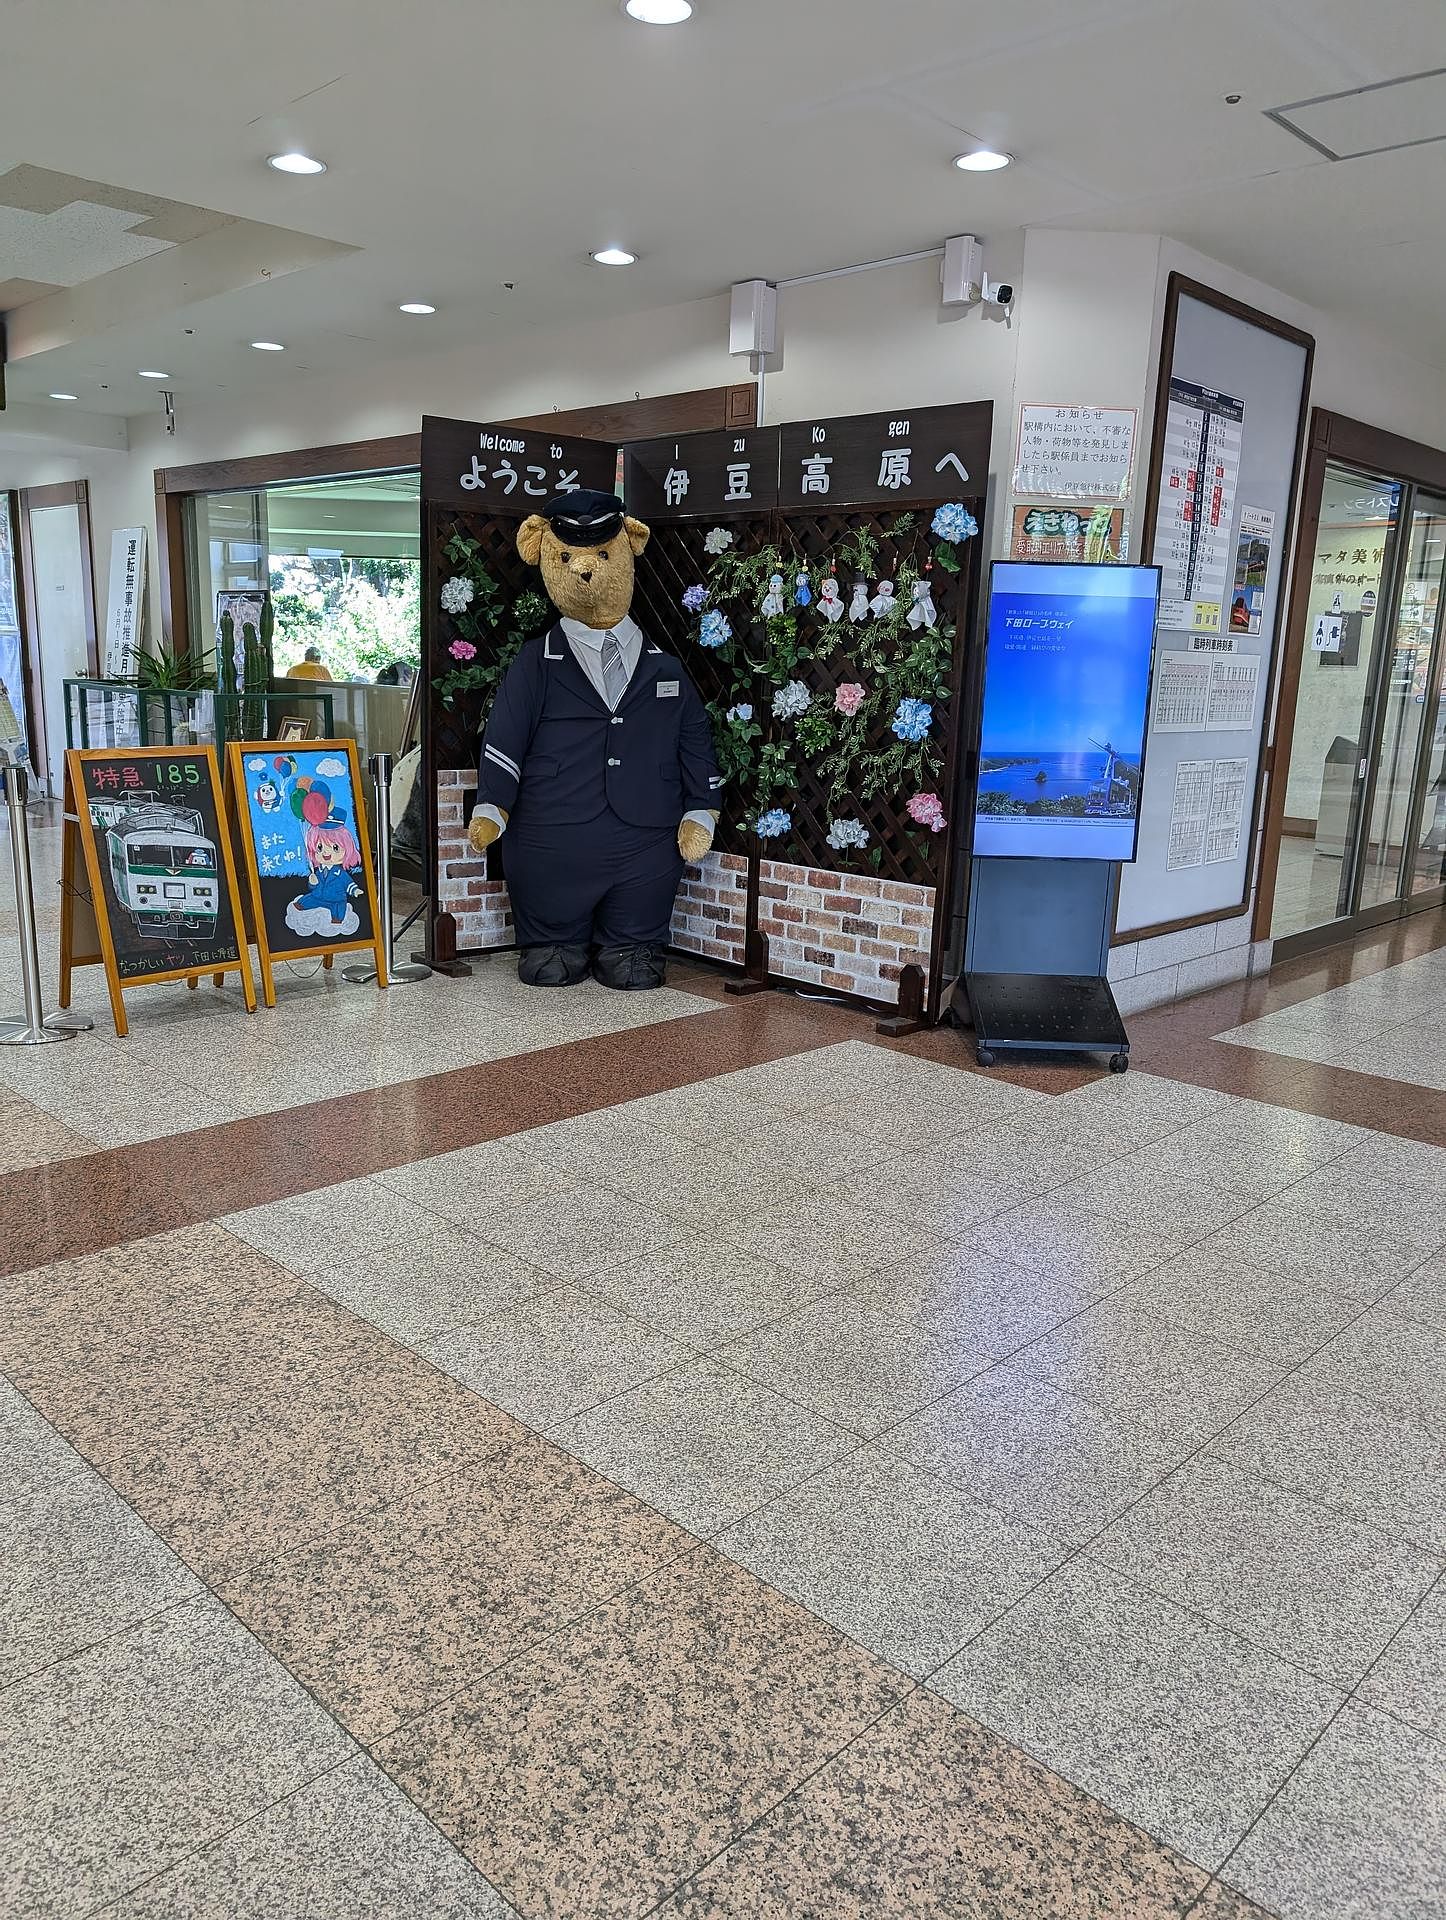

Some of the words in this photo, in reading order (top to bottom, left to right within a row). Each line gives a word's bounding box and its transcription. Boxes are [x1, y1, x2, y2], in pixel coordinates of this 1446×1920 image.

[1055, 408, 1104, 420] お知らせ
[480, 432, 525, 454] Welcome
[550, 443, 563, 459] to
[733, 438, 745, 453] zu
[812, 426, 826, 443] Ko
[888, 420, 910, 438] gen
[459, 455, 581, 496] ようこそ
[1022, 464, 1062, 476] せ下さい。
[92, 766, 144, 790] 特急
[261, 832, 286, 850] また
